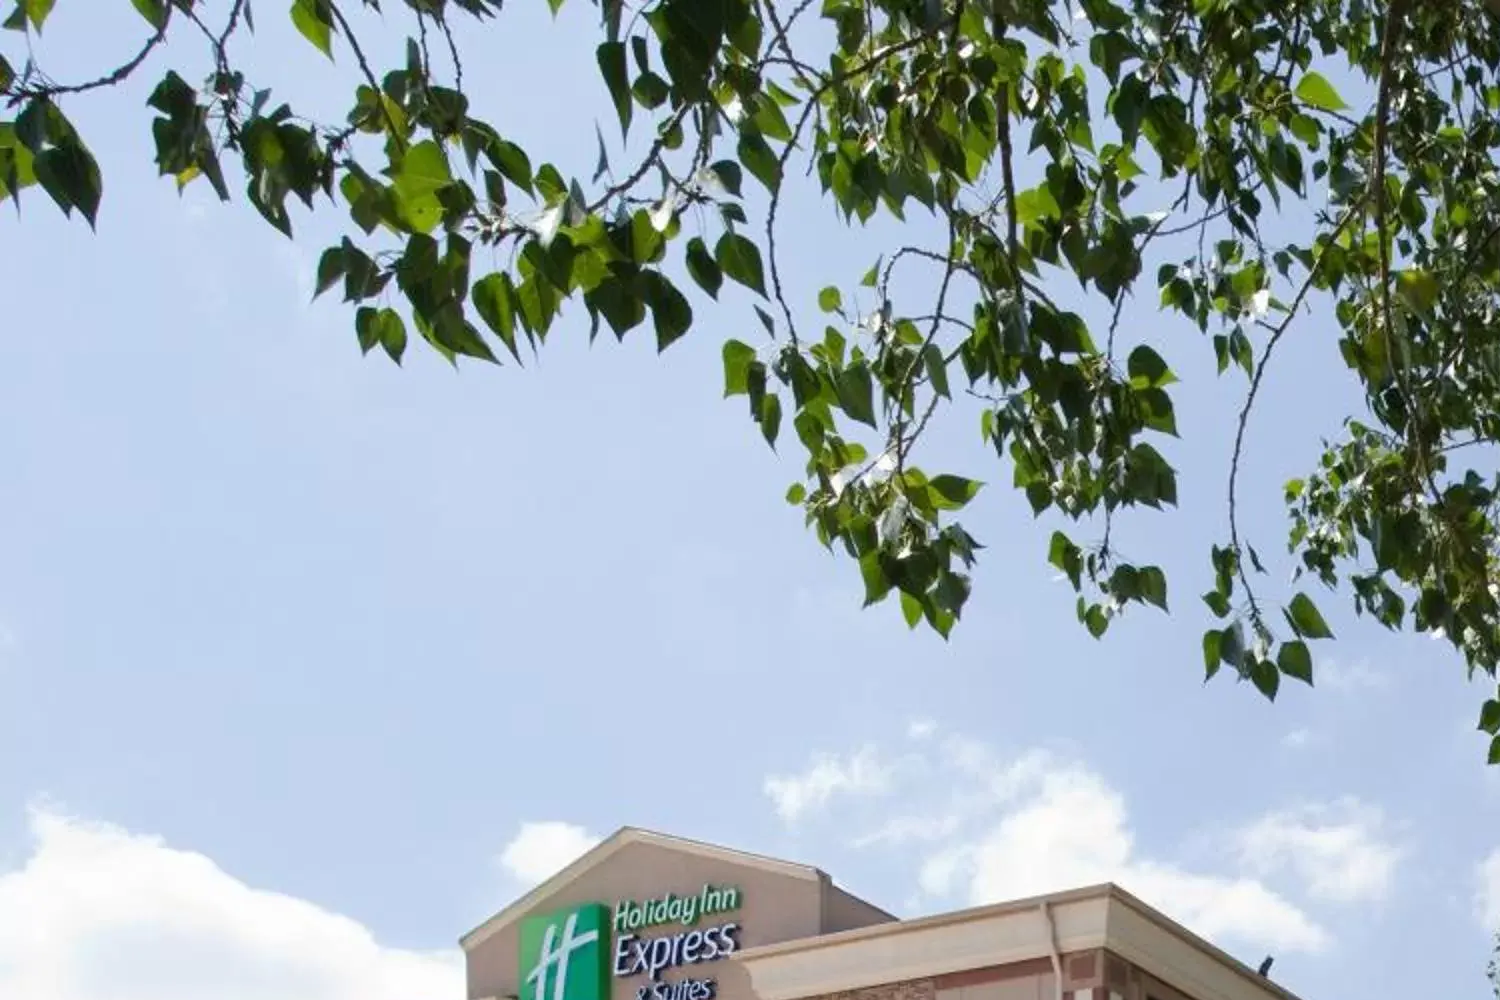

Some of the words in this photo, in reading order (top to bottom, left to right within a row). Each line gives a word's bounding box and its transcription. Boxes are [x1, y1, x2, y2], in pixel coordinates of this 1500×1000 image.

[613, 891, 696, 931] Holiday
[699, 883, 738, 912] Inn
[613, 921, 739, 980] Express
